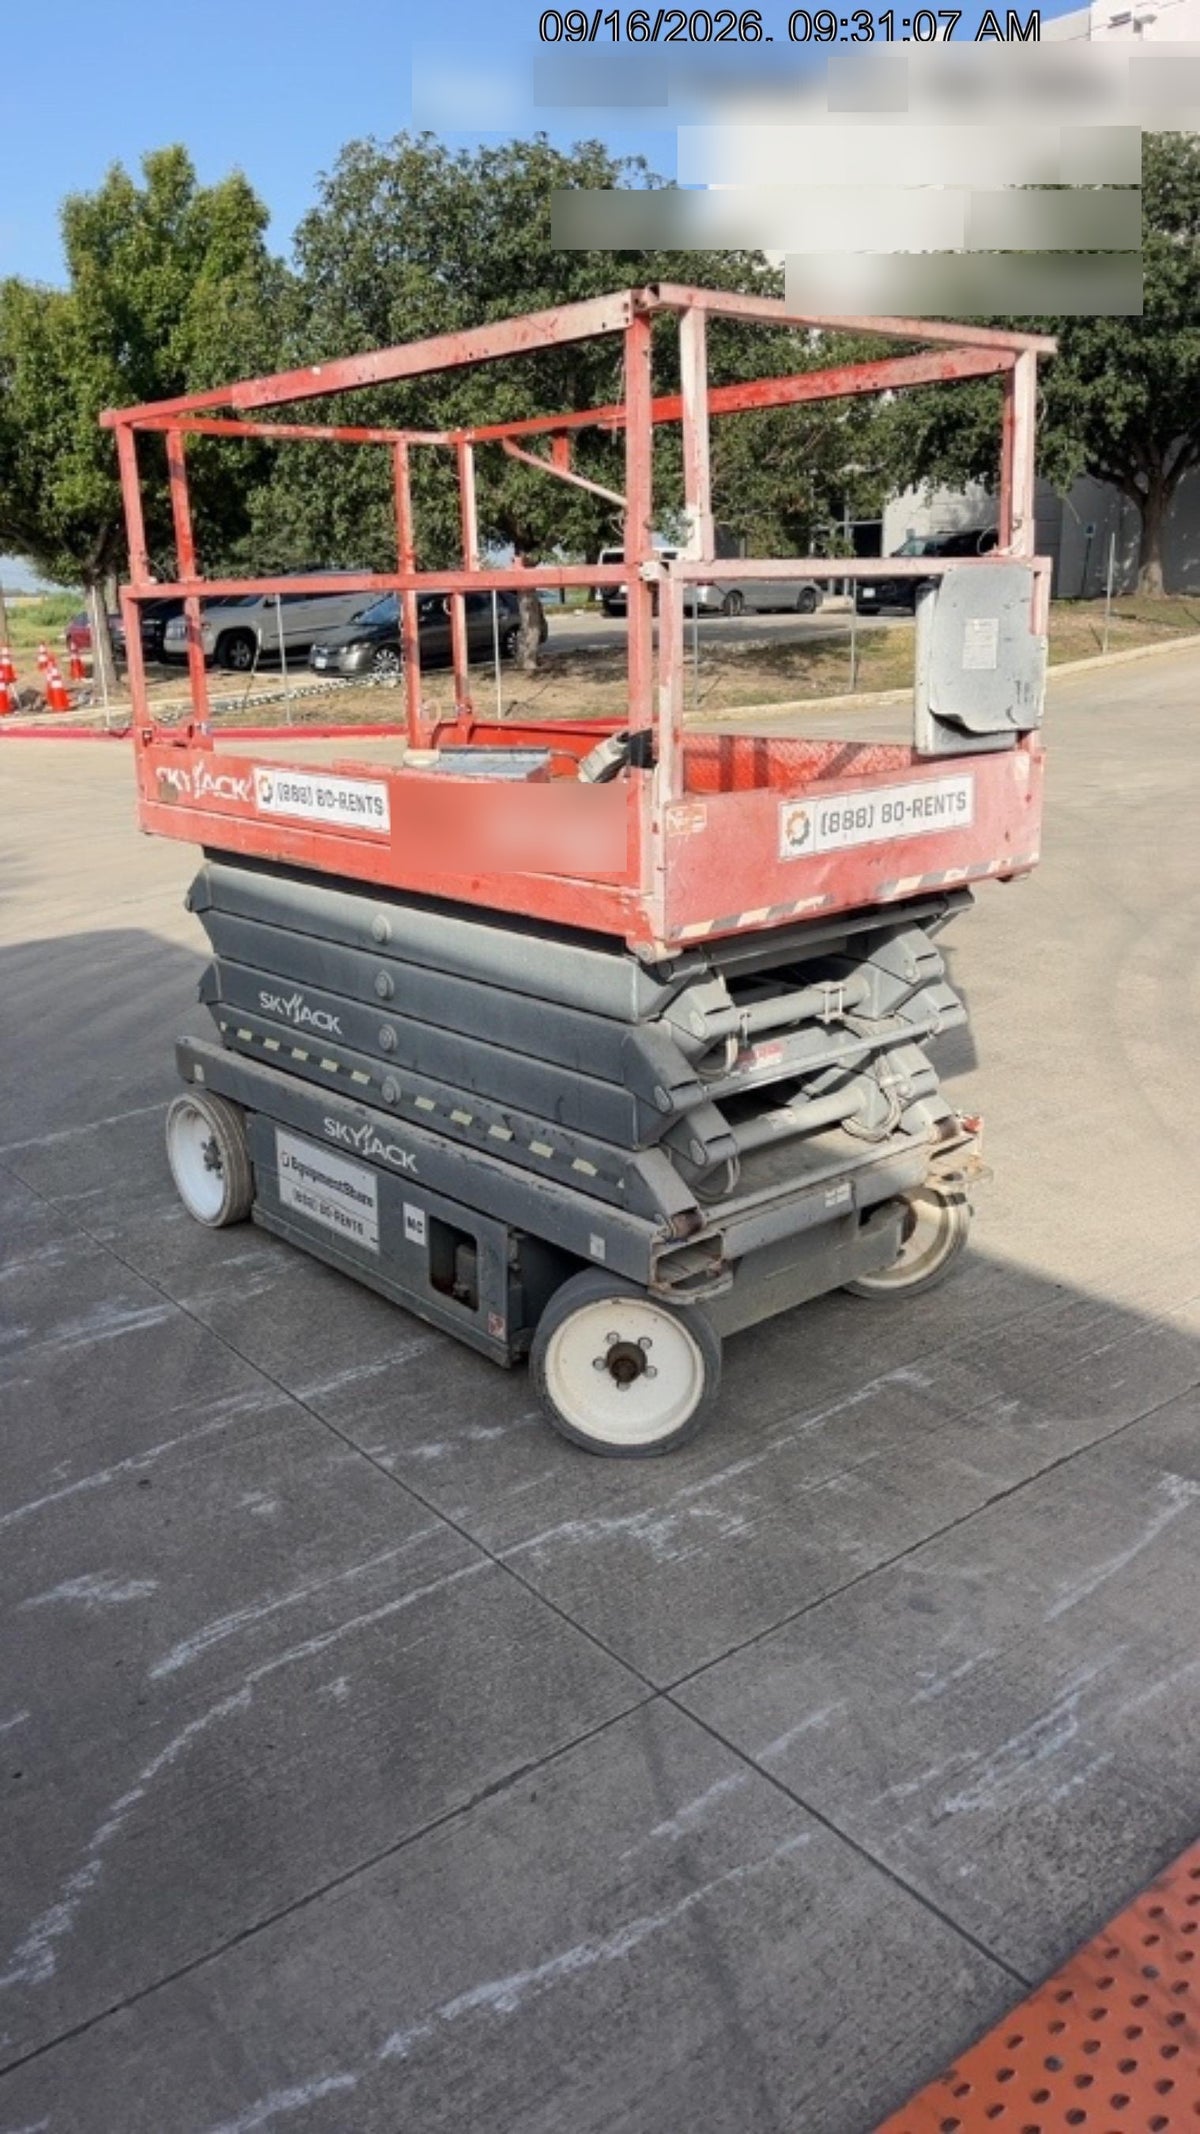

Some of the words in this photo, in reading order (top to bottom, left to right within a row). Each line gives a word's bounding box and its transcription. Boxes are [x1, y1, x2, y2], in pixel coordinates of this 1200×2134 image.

[820, 804, 875, 837] (888)
[881, 790, 967, 824] 80-RENTS
[258, 990, 343, 1035] SKYJACK
[323, 1116, 419, 1174] SKYJACK
